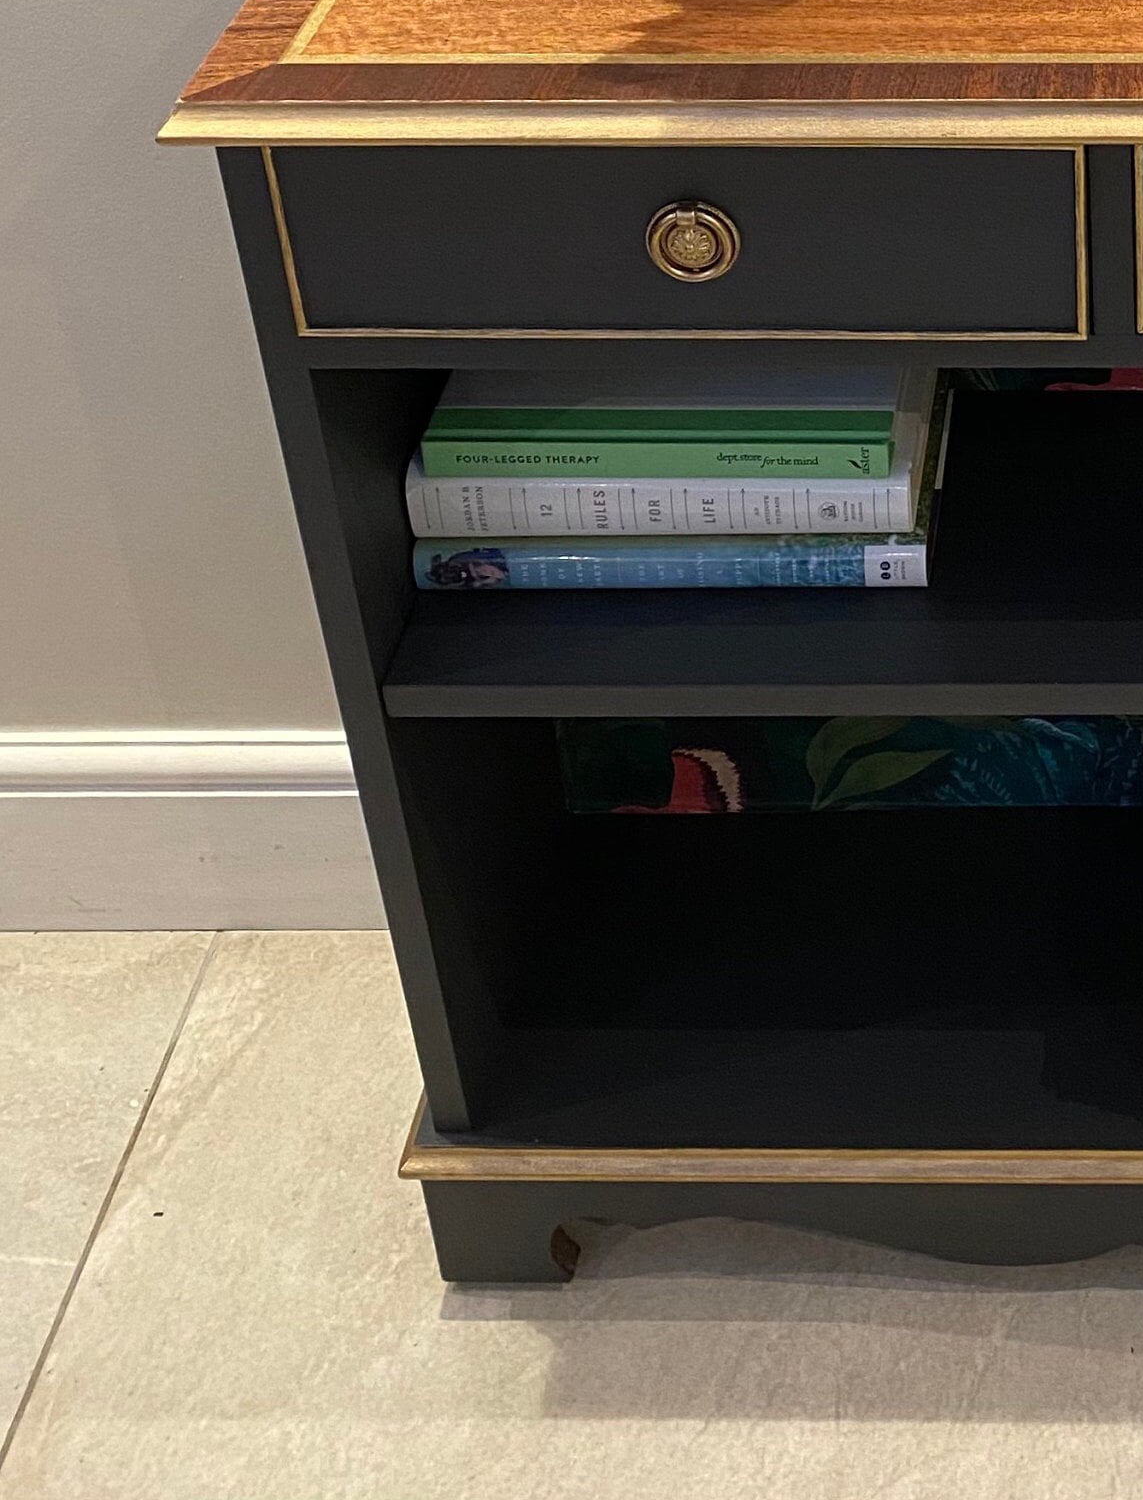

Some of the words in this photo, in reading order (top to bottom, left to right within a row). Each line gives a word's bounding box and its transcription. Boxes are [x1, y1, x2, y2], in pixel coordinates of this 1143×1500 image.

[455, 454, 542, 465] FOUR-LEGGED
[545, 454, 600, 465] THERAPY
[760, 456, 775, 469] for
[776, 456, 792, 466] the
[793, 456, 819, 466] mind
[860, 447, 870, 475] aster
[462, 495, 475, 532] JORDAN
[540, 503, 553, 517] 12
[593, 489, 609, 530] RULES
[648, 499, 662, 523] FOR
[702, 497, 716, 524] LIFE
